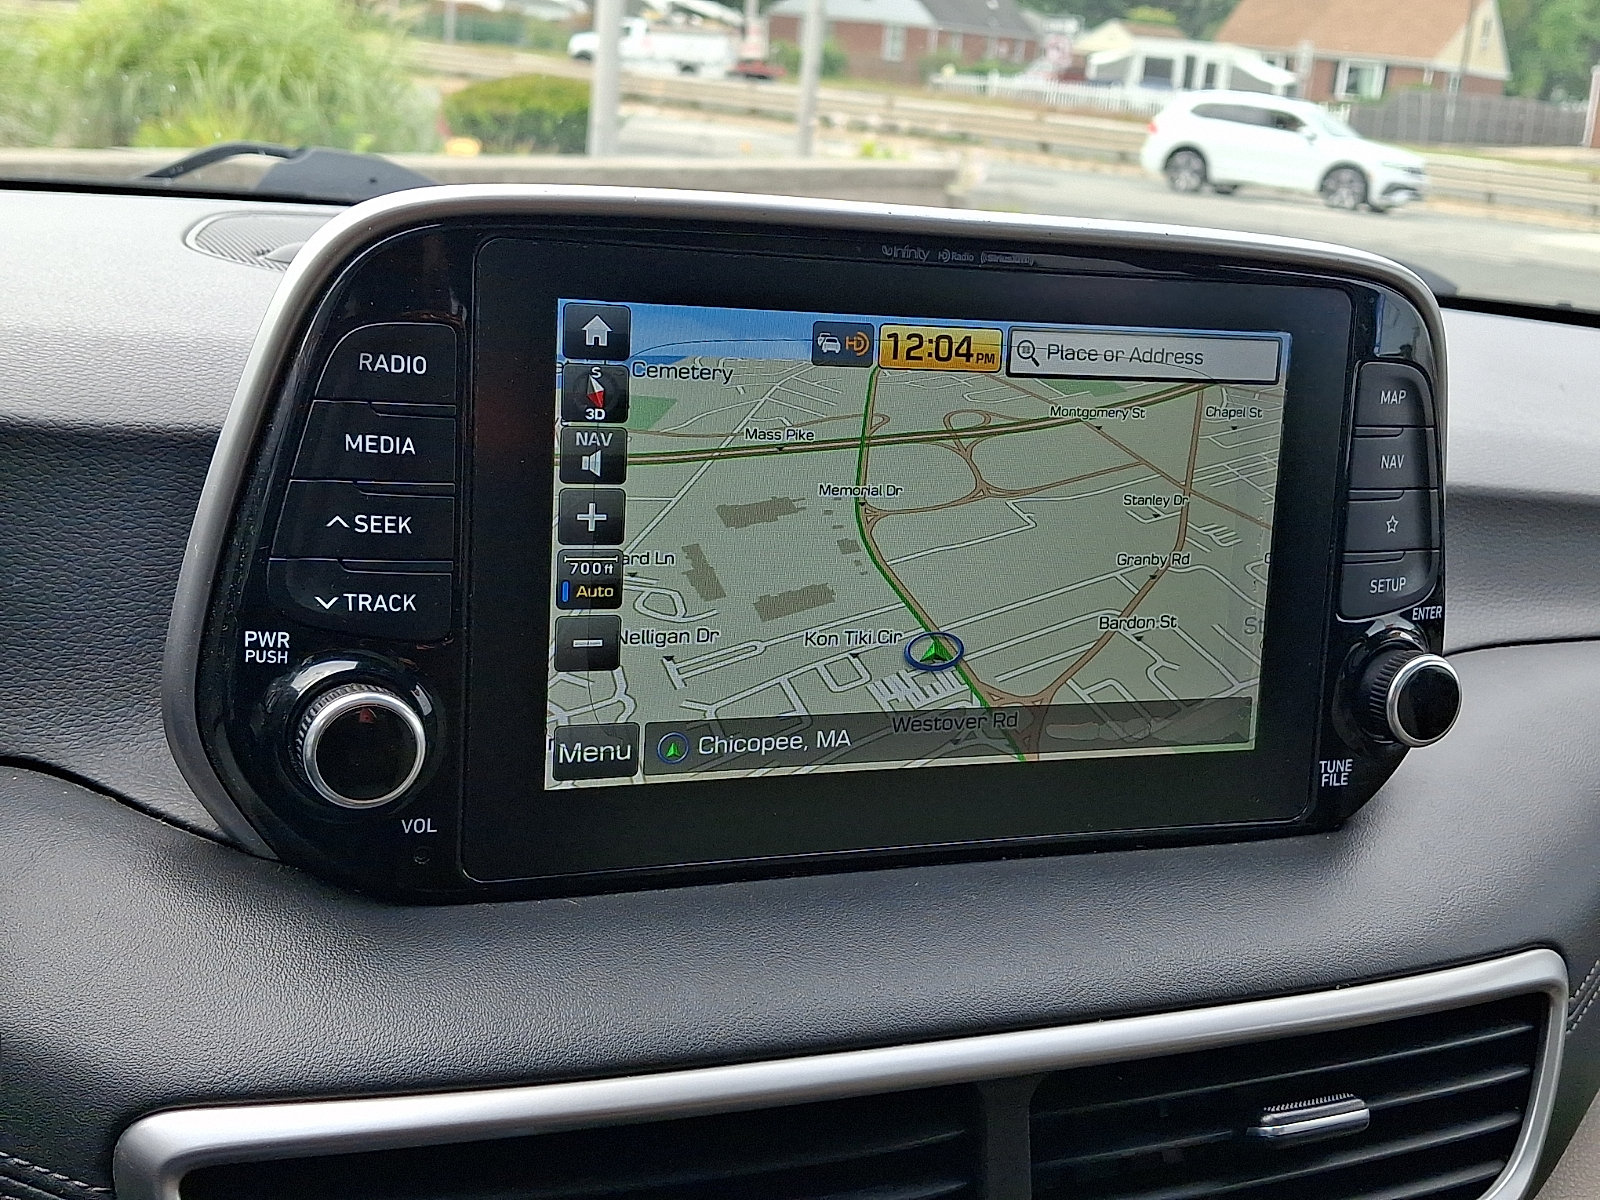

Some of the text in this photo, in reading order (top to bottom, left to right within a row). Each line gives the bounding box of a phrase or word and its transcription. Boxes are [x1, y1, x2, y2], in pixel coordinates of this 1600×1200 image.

[951, 251, 974, 262] Radio
[886, 332, 995, 365] 12:04 PM
[1047, 345, 1205, 366] Place or Address
[358, 352, 427, 375] RADIO
[591, 366, 602, 379] S
[632, 361, 734, 386] Cemetery
[1380, 389, 1407, 405] MAP
[585, 408, 606, 421] 3D
[1050, 405, 1146, 419] Montgomery St
[1205, 405, 1263, 420] Chapel St
[575, 431, 613, 448] NAV
[745, 428, 815, 442] Mass Pike
[344, 433, 416, 456] MEDIA
[1380, 454, 1405, 470] NAV
[819, 483, 904, 497] Memorial Dr
[1123, 493, 1189, 509] Stanley Dr
[354, 514, 412, 535] SEEK
[655, 552, 675, 565] Ln
[1117, 553, 1190, 568] Granby Rd
[570, 562, 602, 576] 700
[576, 585, 614, 599] Auto
[1369, 577, 1407, 594] SETUP
[343, 594, 417, 612] TRACK
[1412, 605, 1443, 621] ENTER
[1099, 615, 1178, 631] Bardon St
[244, 630, 291, 649] PWR
[621, 628, 720, 649] Nelligan Dr
[805, 630, 903, 647] Kon Tiki Cir
[244, 649, 289, 664] PUSH
[892, 712, 1018, 733] Westover Rd
[699, 730, 851, 756] Chicopee, MA
[558, 740, 631, 764] Menu
[1319, 759, 1353, 773] TUNE
[1321, 772, 1349, 787] FILE
[401, 818, 437, 833] VOL
